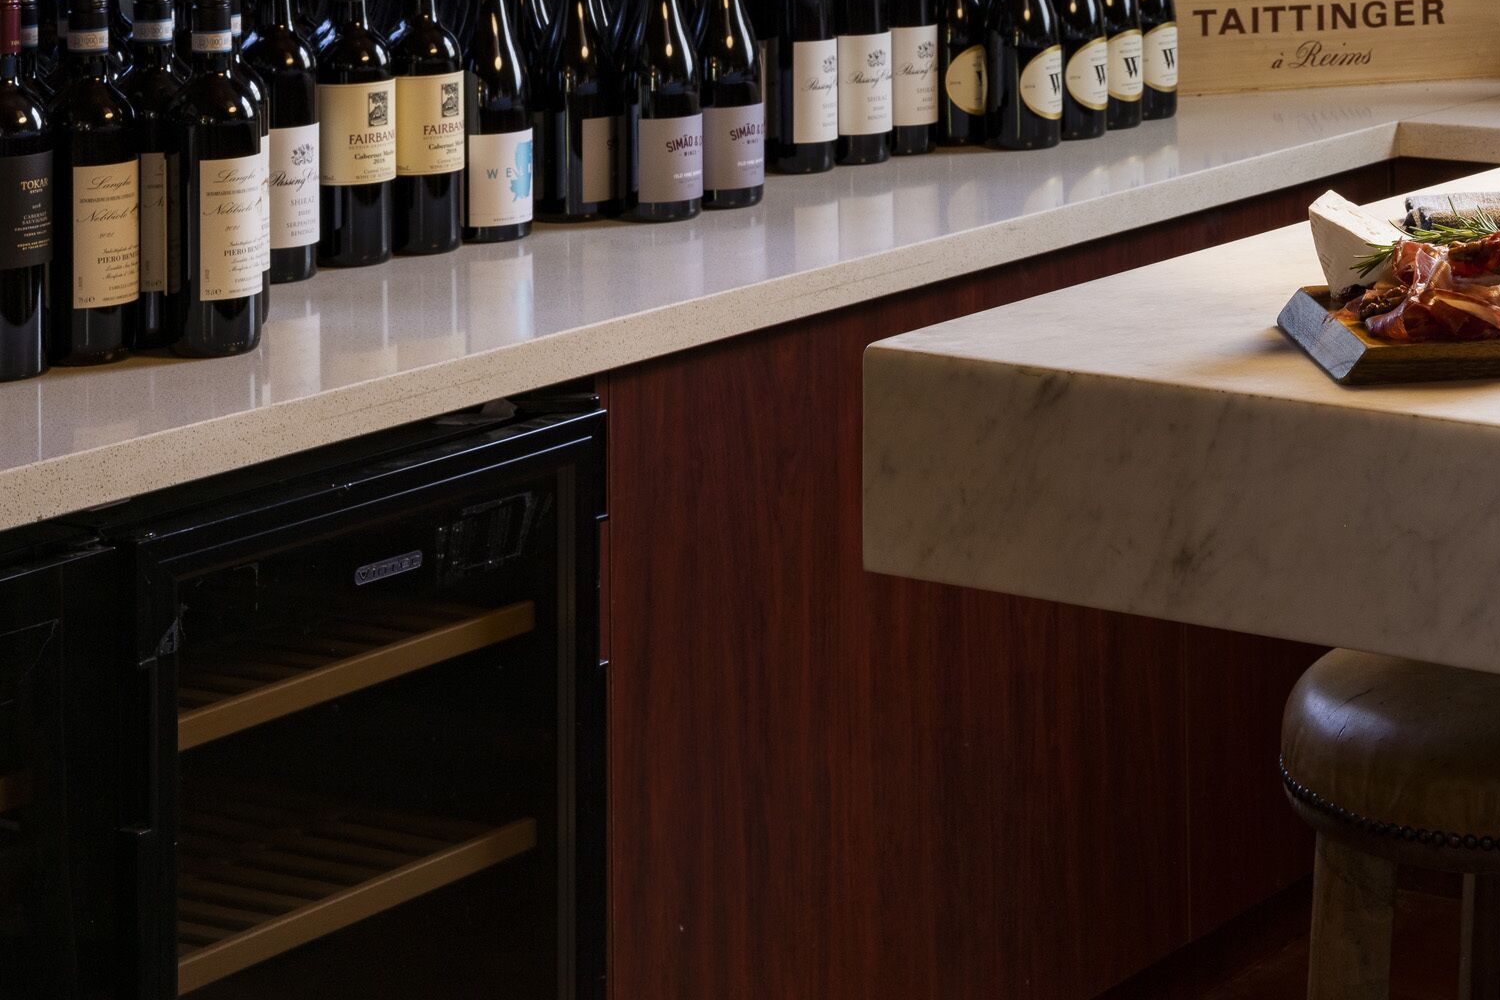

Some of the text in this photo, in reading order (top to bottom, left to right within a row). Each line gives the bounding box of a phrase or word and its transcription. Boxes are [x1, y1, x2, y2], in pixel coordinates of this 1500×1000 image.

[1271, 40, 1373, 69] à Reims
[1122, 55, 1140, 79] W
[423, 121, 464, 136] FAIRBAN
[730, 122, 756, 141] SIMÃO
[665, 134, 693, 153] SIMÃO
[20, 177, 49, 191] TOKAR
